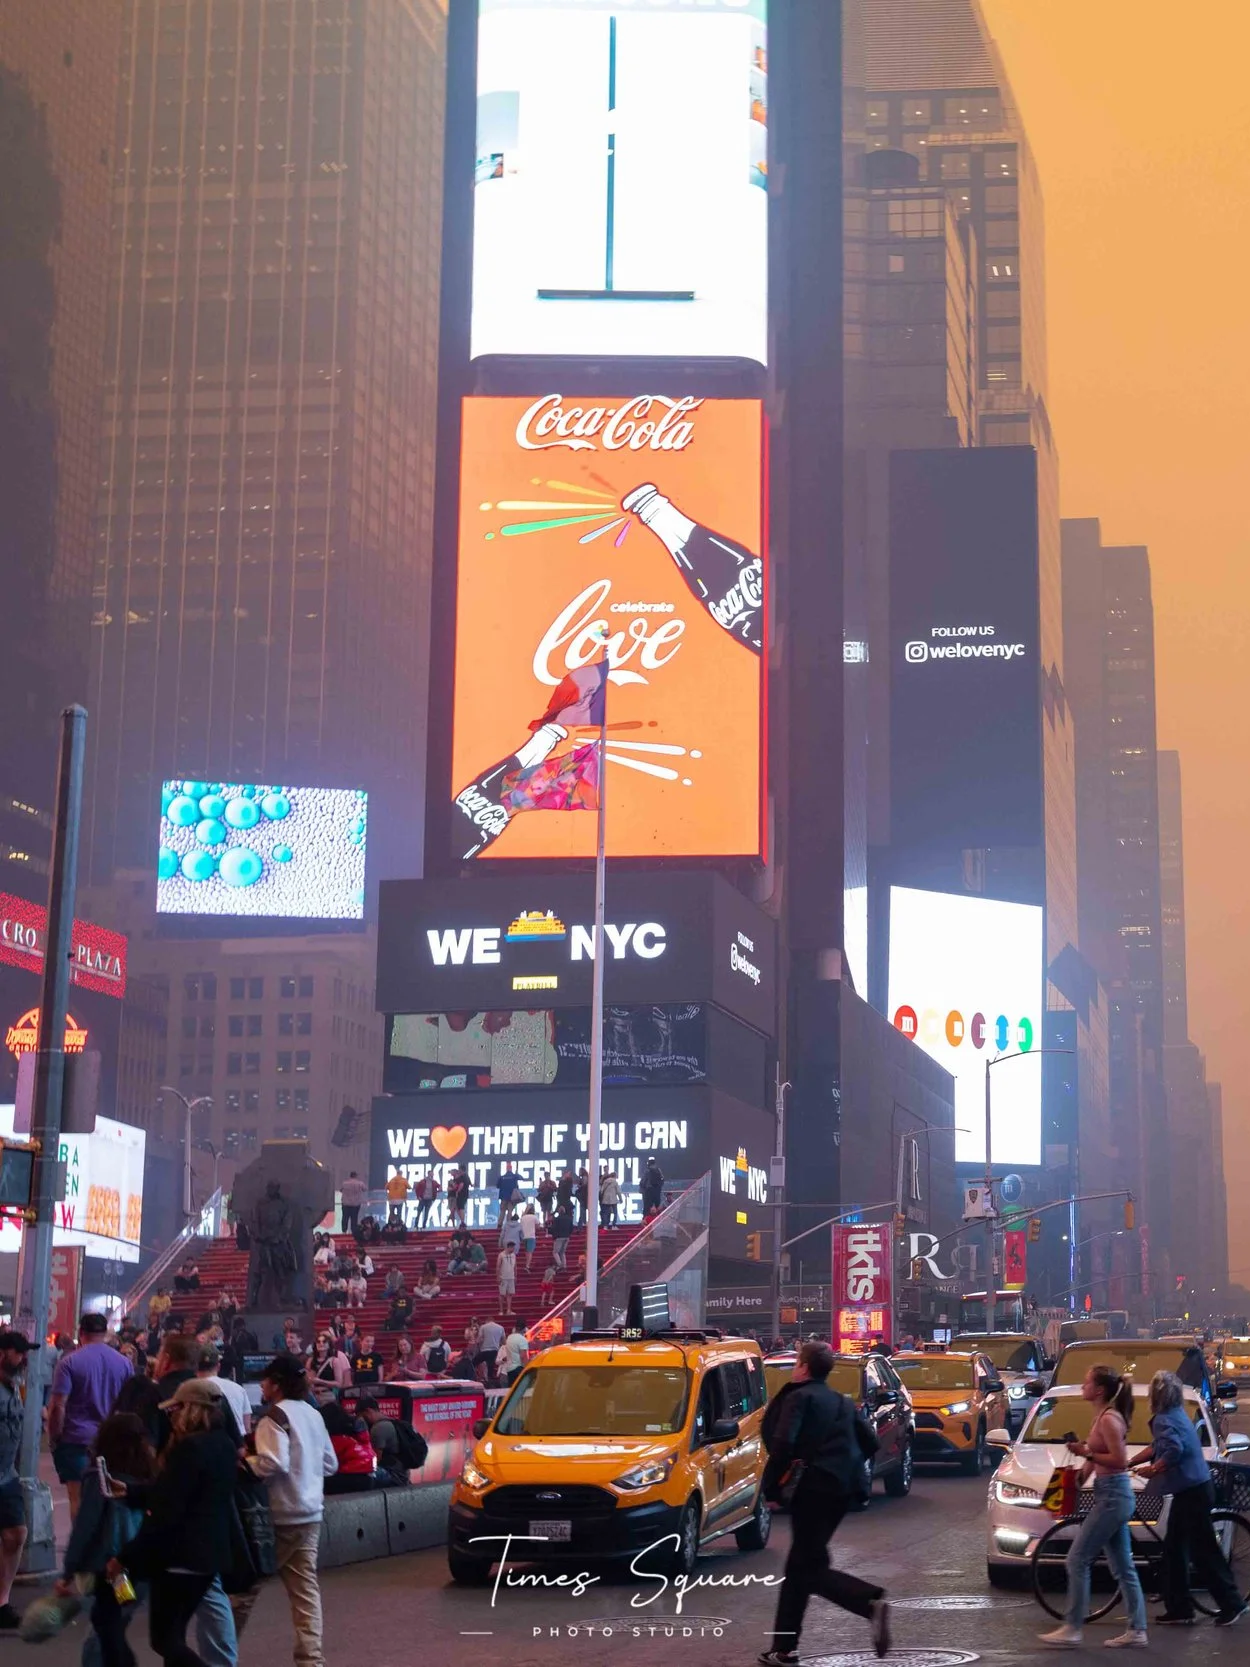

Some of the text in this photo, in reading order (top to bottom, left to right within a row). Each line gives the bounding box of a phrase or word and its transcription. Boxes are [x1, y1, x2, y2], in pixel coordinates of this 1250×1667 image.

[515, 393, 705, 451] Coca-Cola
[609, 601, 675, 613] celebrate
[707, 557, 763, 629] Coca-Co
[532, 578, 686, 687] love
[929, 642, 1025, 660] welovenyc
[931, 626, 995, 637] FOLLOW US
[426, 922, 666, 966] WE NYC
[387, 1120, 687, 1158] WE THAT IF YOU CAN
[467, 1161, 492, 1191] IT
[575, 1156, 656, 1187] YOU'L
[719, 1155, 768, 1204] WE NYC
[846, 1230, 882, 1301] tkts
[906, 1232, 956, 1280] R
[705, 1296, 762, 1309] amily Here
